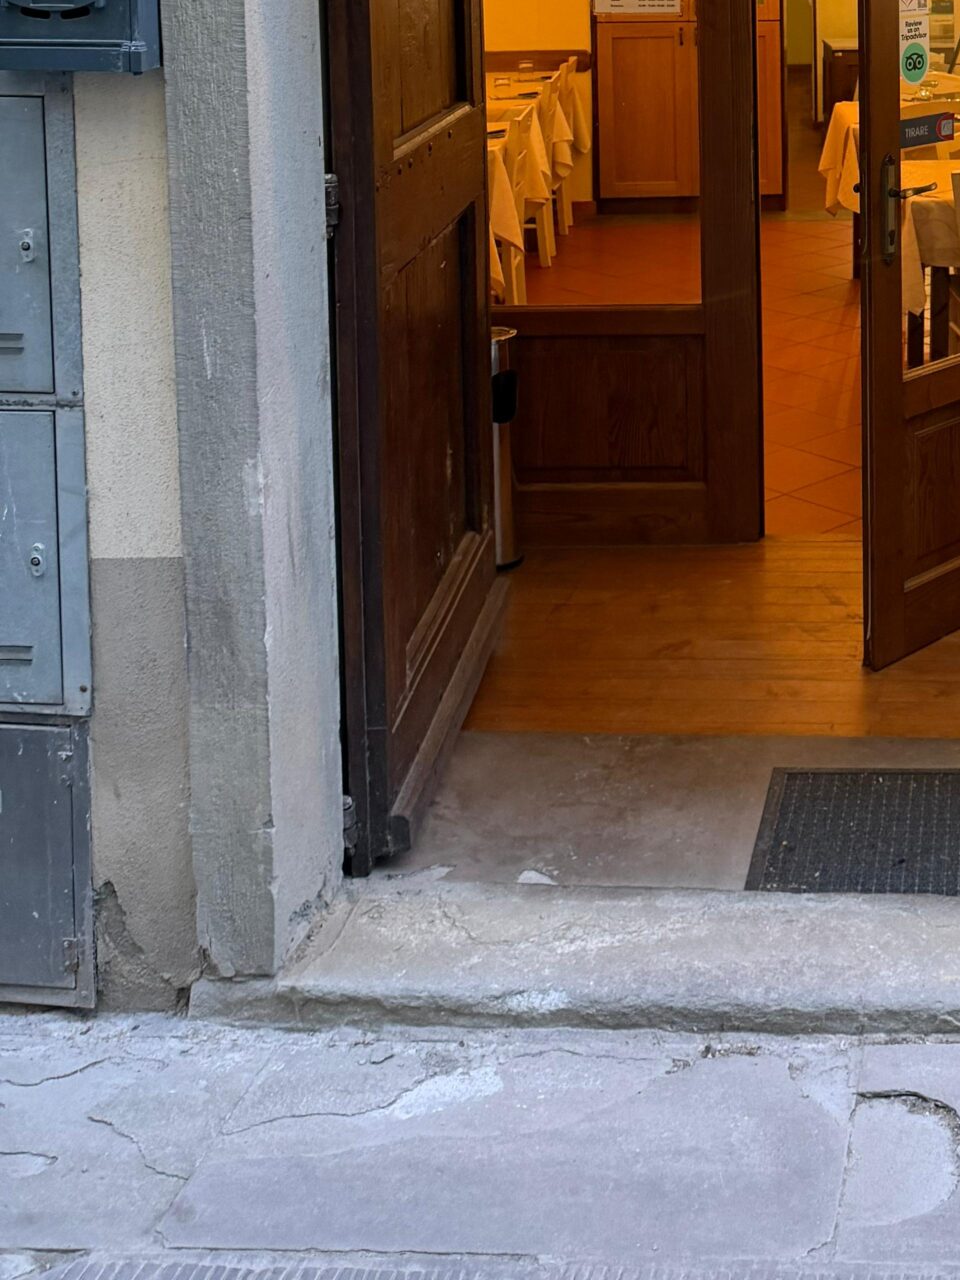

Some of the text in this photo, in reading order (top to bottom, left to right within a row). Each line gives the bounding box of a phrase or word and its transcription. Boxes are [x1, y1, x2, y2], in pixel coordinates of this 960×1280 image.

[905, 20, 923, 28] Review
[901, 32, 928, 42] Tripadvisor
[905, 125, 929, 139] TIRARE
